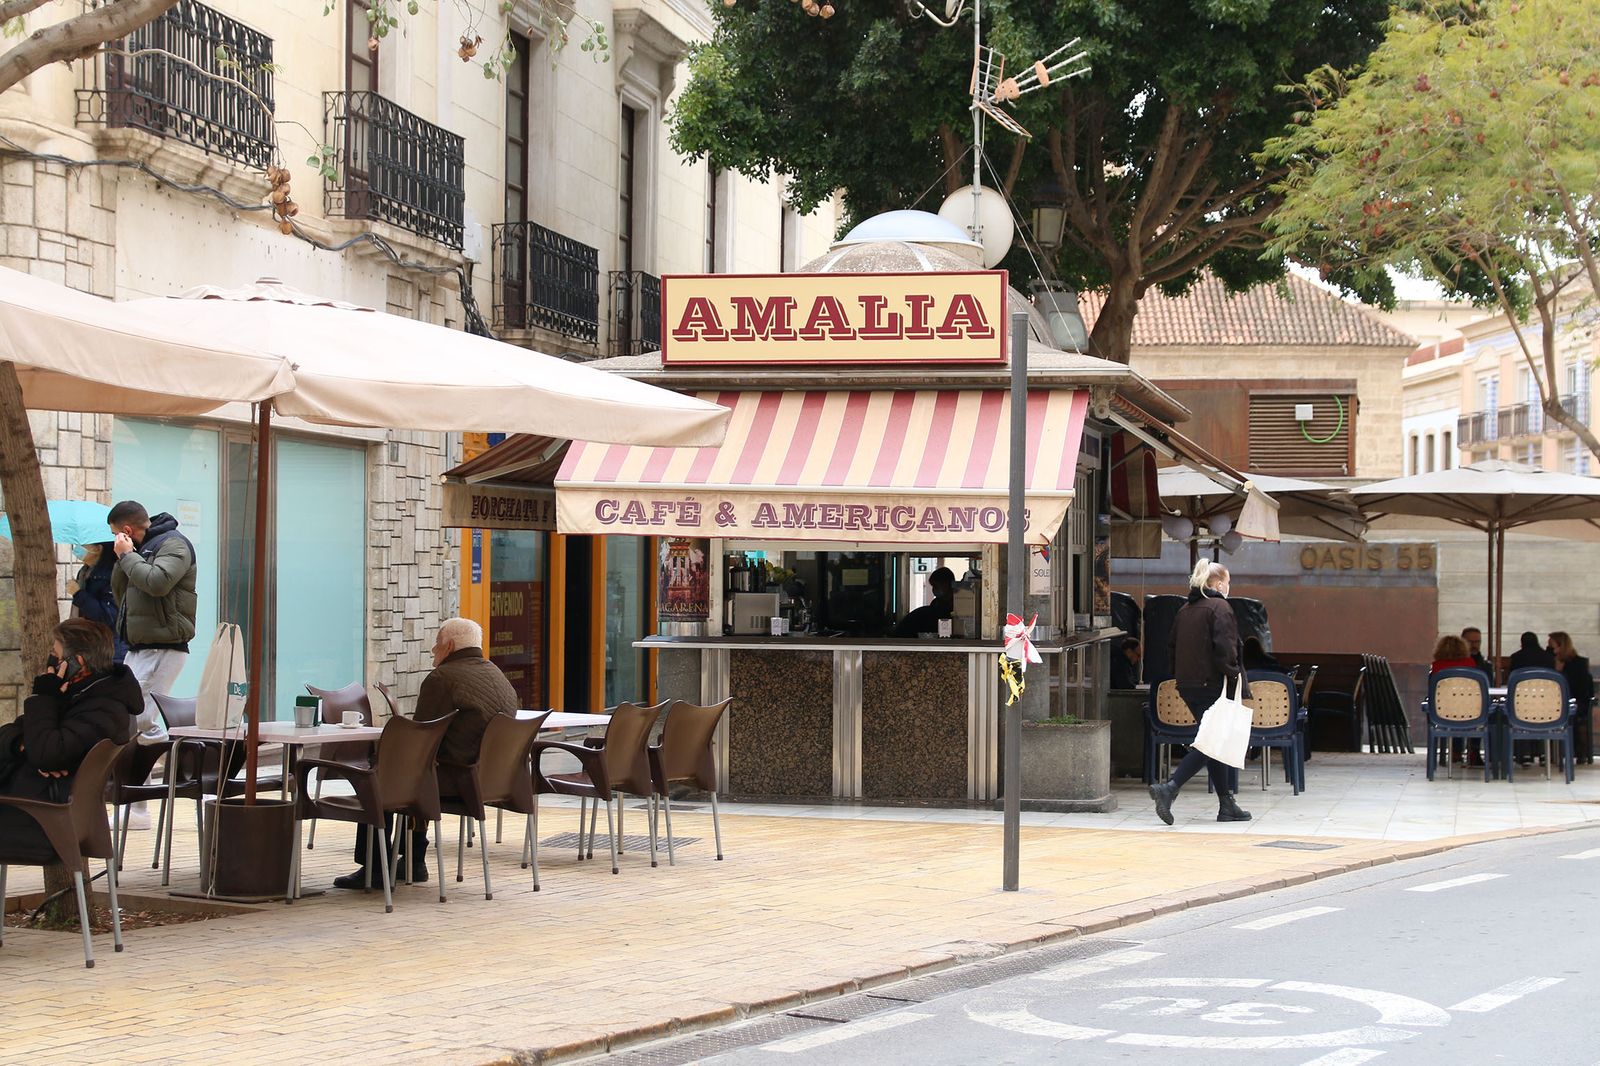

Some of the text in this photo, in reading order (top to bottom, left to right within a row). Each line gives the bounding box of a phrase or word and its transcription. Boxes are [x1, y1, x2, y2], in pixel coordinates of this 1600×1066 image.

[672, 293, 996, 342] AMALIA
[470, 495, 539, 522] HORCHATA
[595, 496, 702, 527] CAFÉ
[715, 501, 738, 527] &
[1300, 546, 1433, 570] OASIS 55
